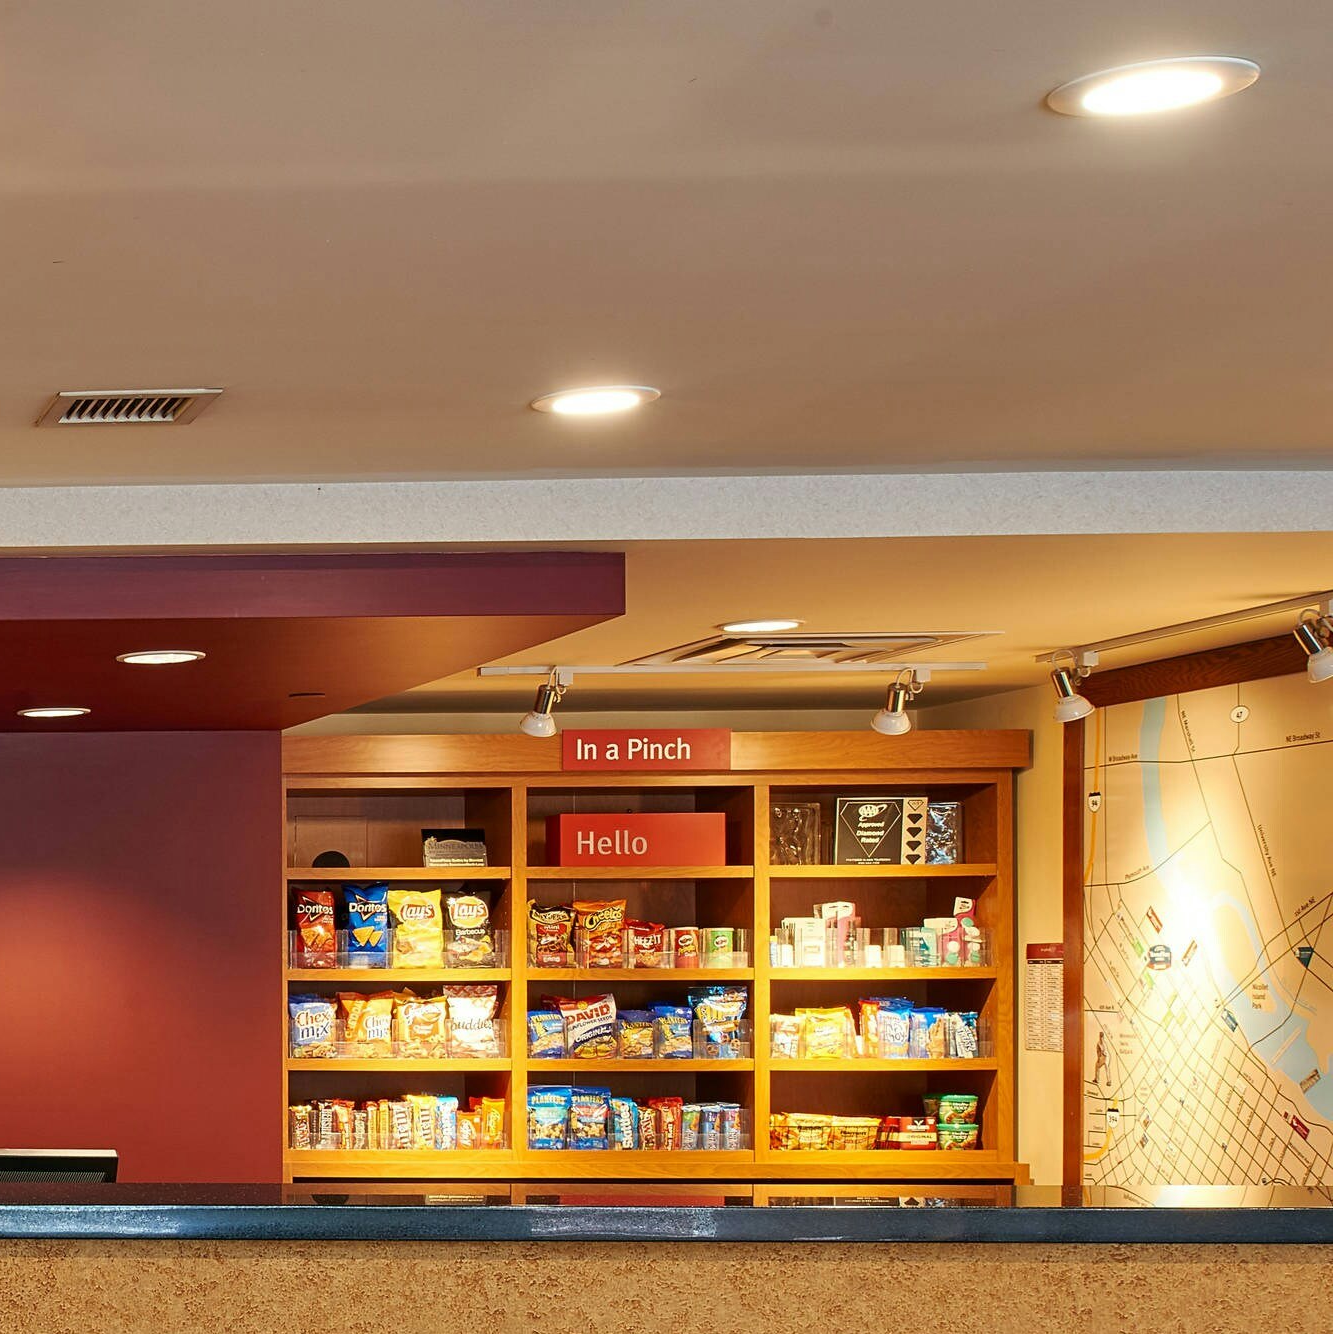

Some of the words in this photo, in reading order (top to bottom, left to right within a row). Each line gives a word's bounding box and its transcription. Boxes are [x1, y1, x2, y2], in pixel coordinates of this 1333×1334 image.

[576, 739, 597, 760] In
[605, 743, 619, 760] a
[628, 737, 691, 760] Pinch
[576, 830, 648, 855] Hello
[297, 904, 333, 915] Doritos
[349, 903, 387, 913] Doritos
[296, 1011, 330, 1027] Chex
[565, 1003, 610, 1024] DAVID
